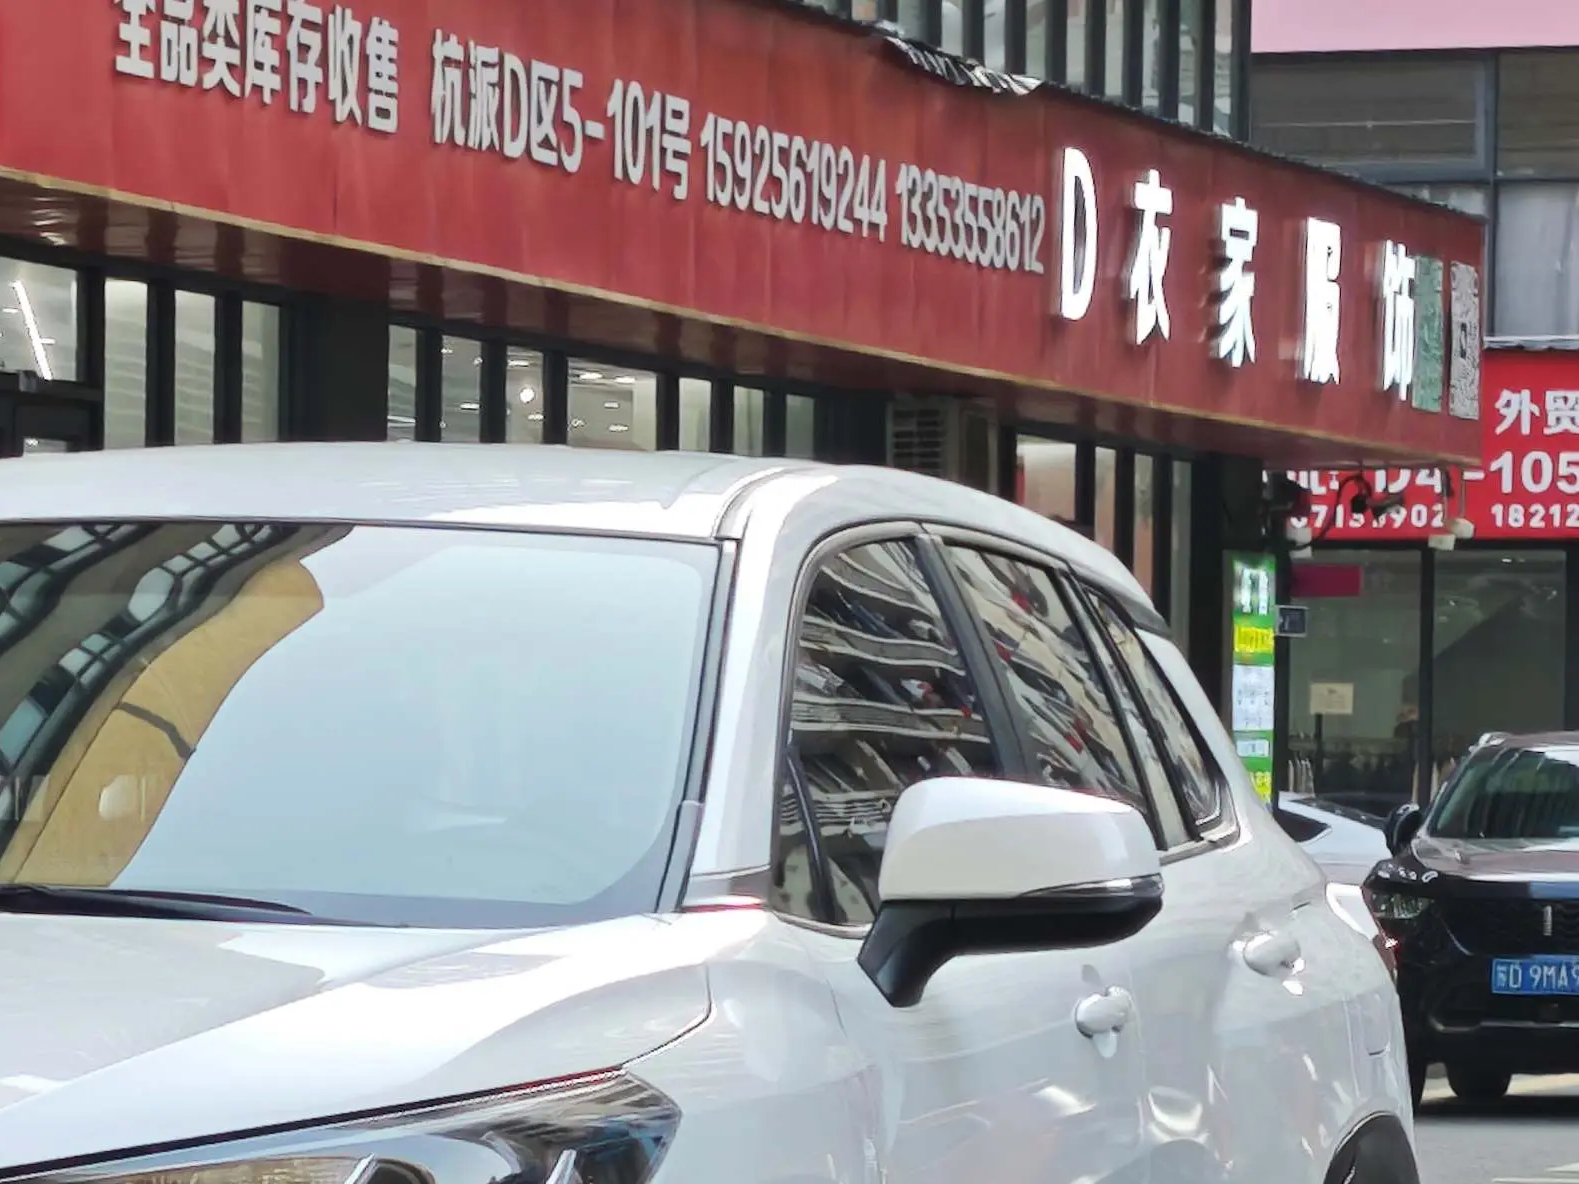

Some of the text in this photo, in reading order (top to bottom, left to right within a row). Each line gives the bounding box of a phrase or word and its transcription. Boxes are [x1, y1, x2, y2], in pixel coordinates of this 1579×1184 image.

[430, 28, 692, 201] 杭派D区5-101号
[699, 112, 888, 243] 15925619244
[894, 163, 1045, 274] 13353558612
